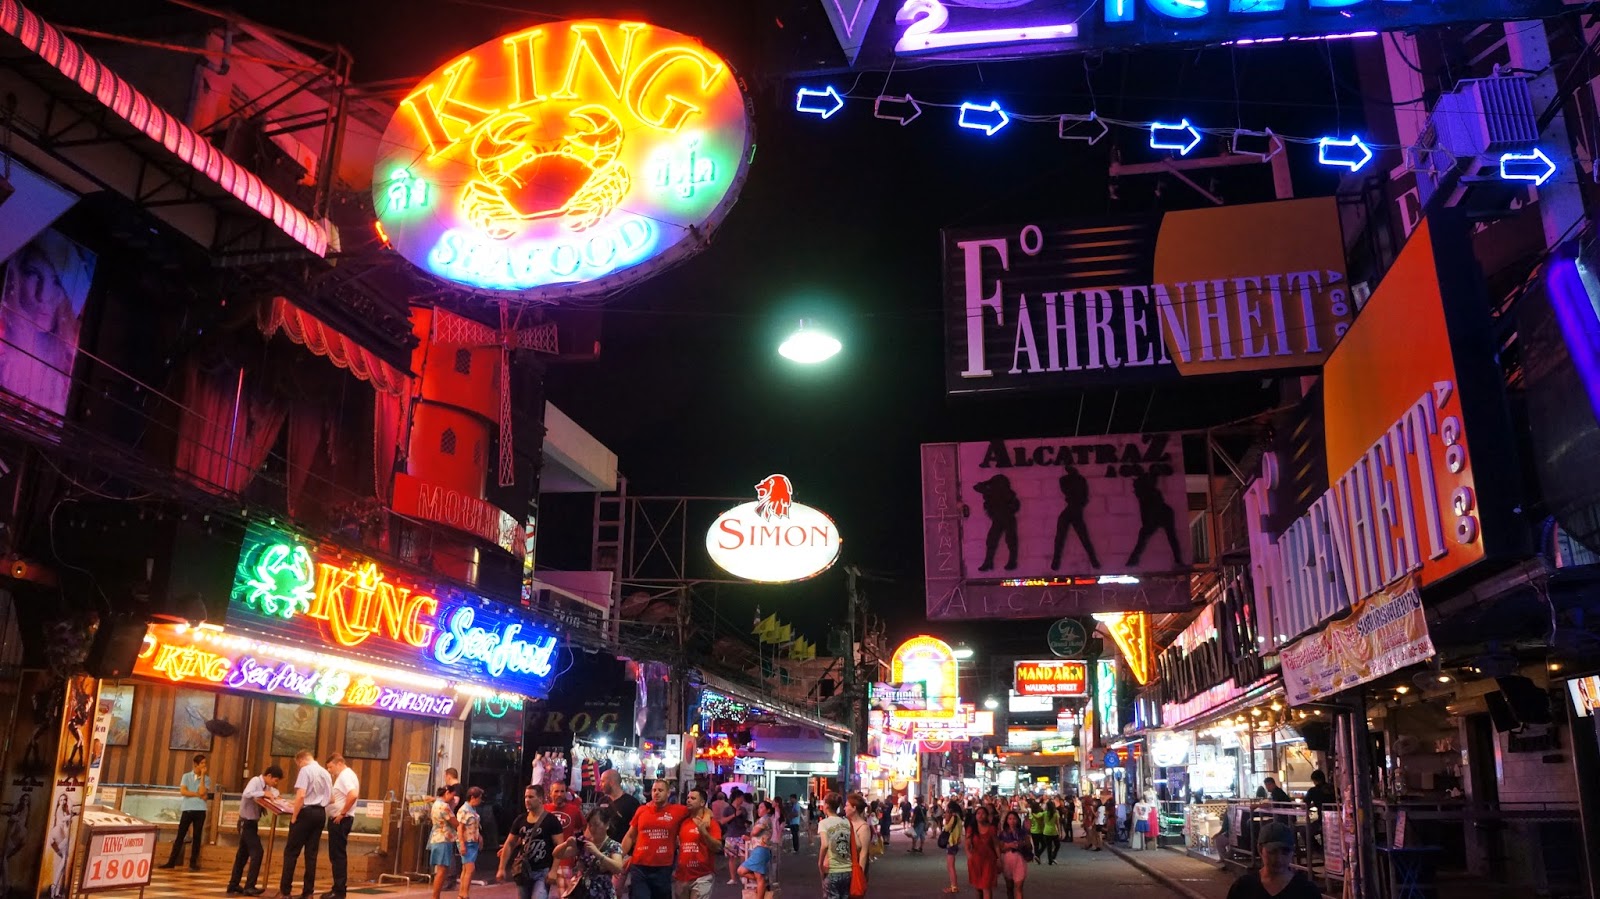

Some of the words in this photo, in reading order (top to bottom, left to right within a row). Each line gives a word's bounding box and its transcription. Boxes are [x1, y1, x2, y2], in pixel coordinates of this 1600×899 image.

[401, 22, 722, 161] KING
[431, 216, 656, 282] SEAFOOD
[957, 238, 1323, 378] FAHRENHEIT
[979, 433, 1172, 469] ALCATRAZ
[718, 518, 829, 550] SIMON
[311, 562, 438, 647] KING
[943, 586, 1187, 616] ALCATRAZ
[436, 605, 558, 678] Seafood
[153, 643, 231, 681] KING
[1017, 666, 1083, 681] MANDARIN
[1024, 683, 1056, 692] WALKING
[1056, 683, 1078, 692] STREET
[102, 836, 124, 853] KING
[124, 837, 144, 848] LOBSTER
[90, 858, 149, 881] 1800
